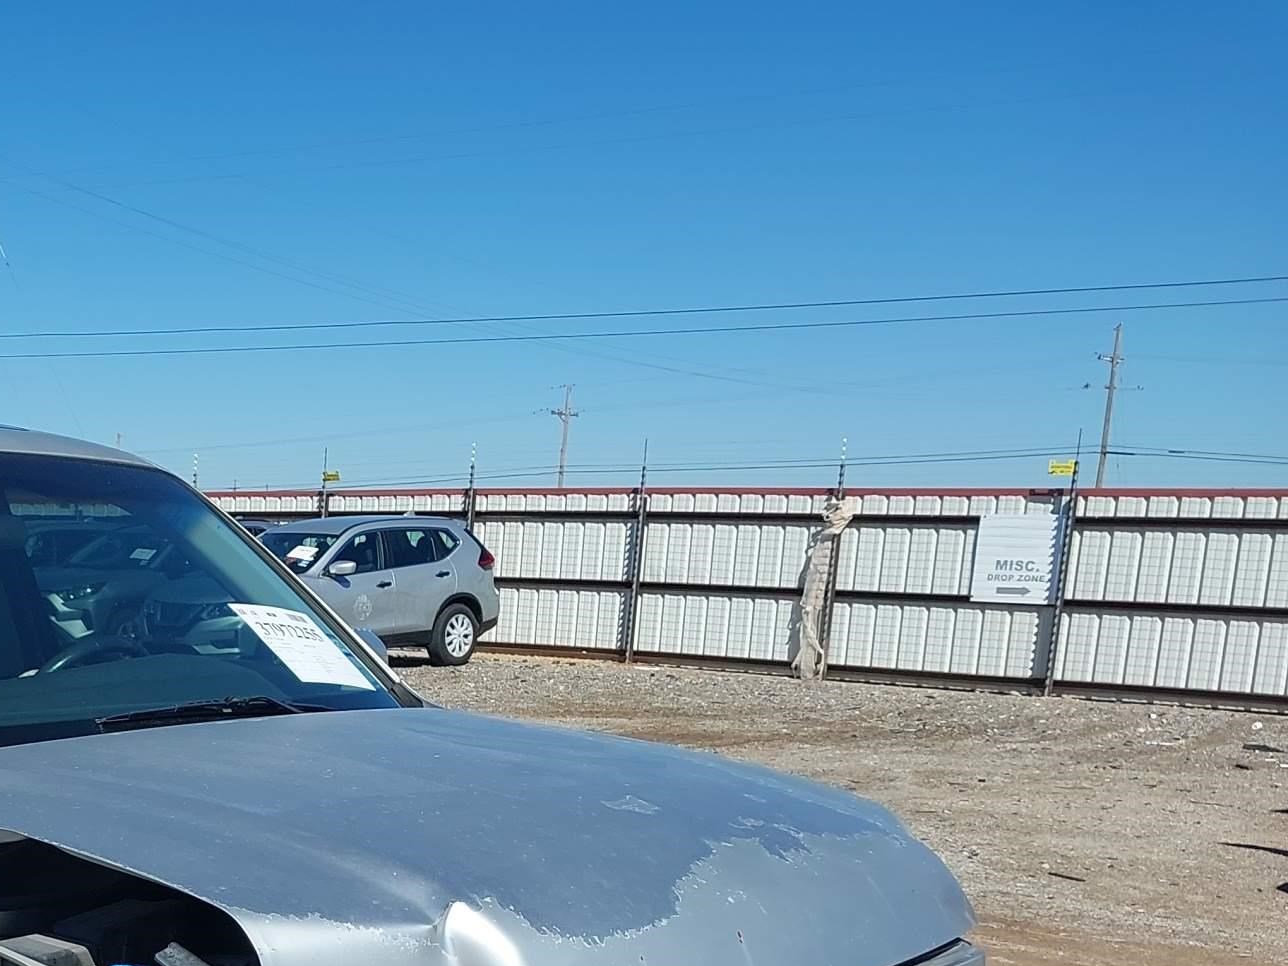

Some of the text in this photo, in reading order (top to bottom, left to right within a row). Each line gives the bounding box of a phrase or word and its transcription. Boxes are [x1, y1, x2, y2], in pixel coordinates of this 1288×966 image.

[995, 559, 1040, 572] MISC.
[987, 574, 1046, 583] DROP ZONE
[255, 621, 325, 642] 37972255
